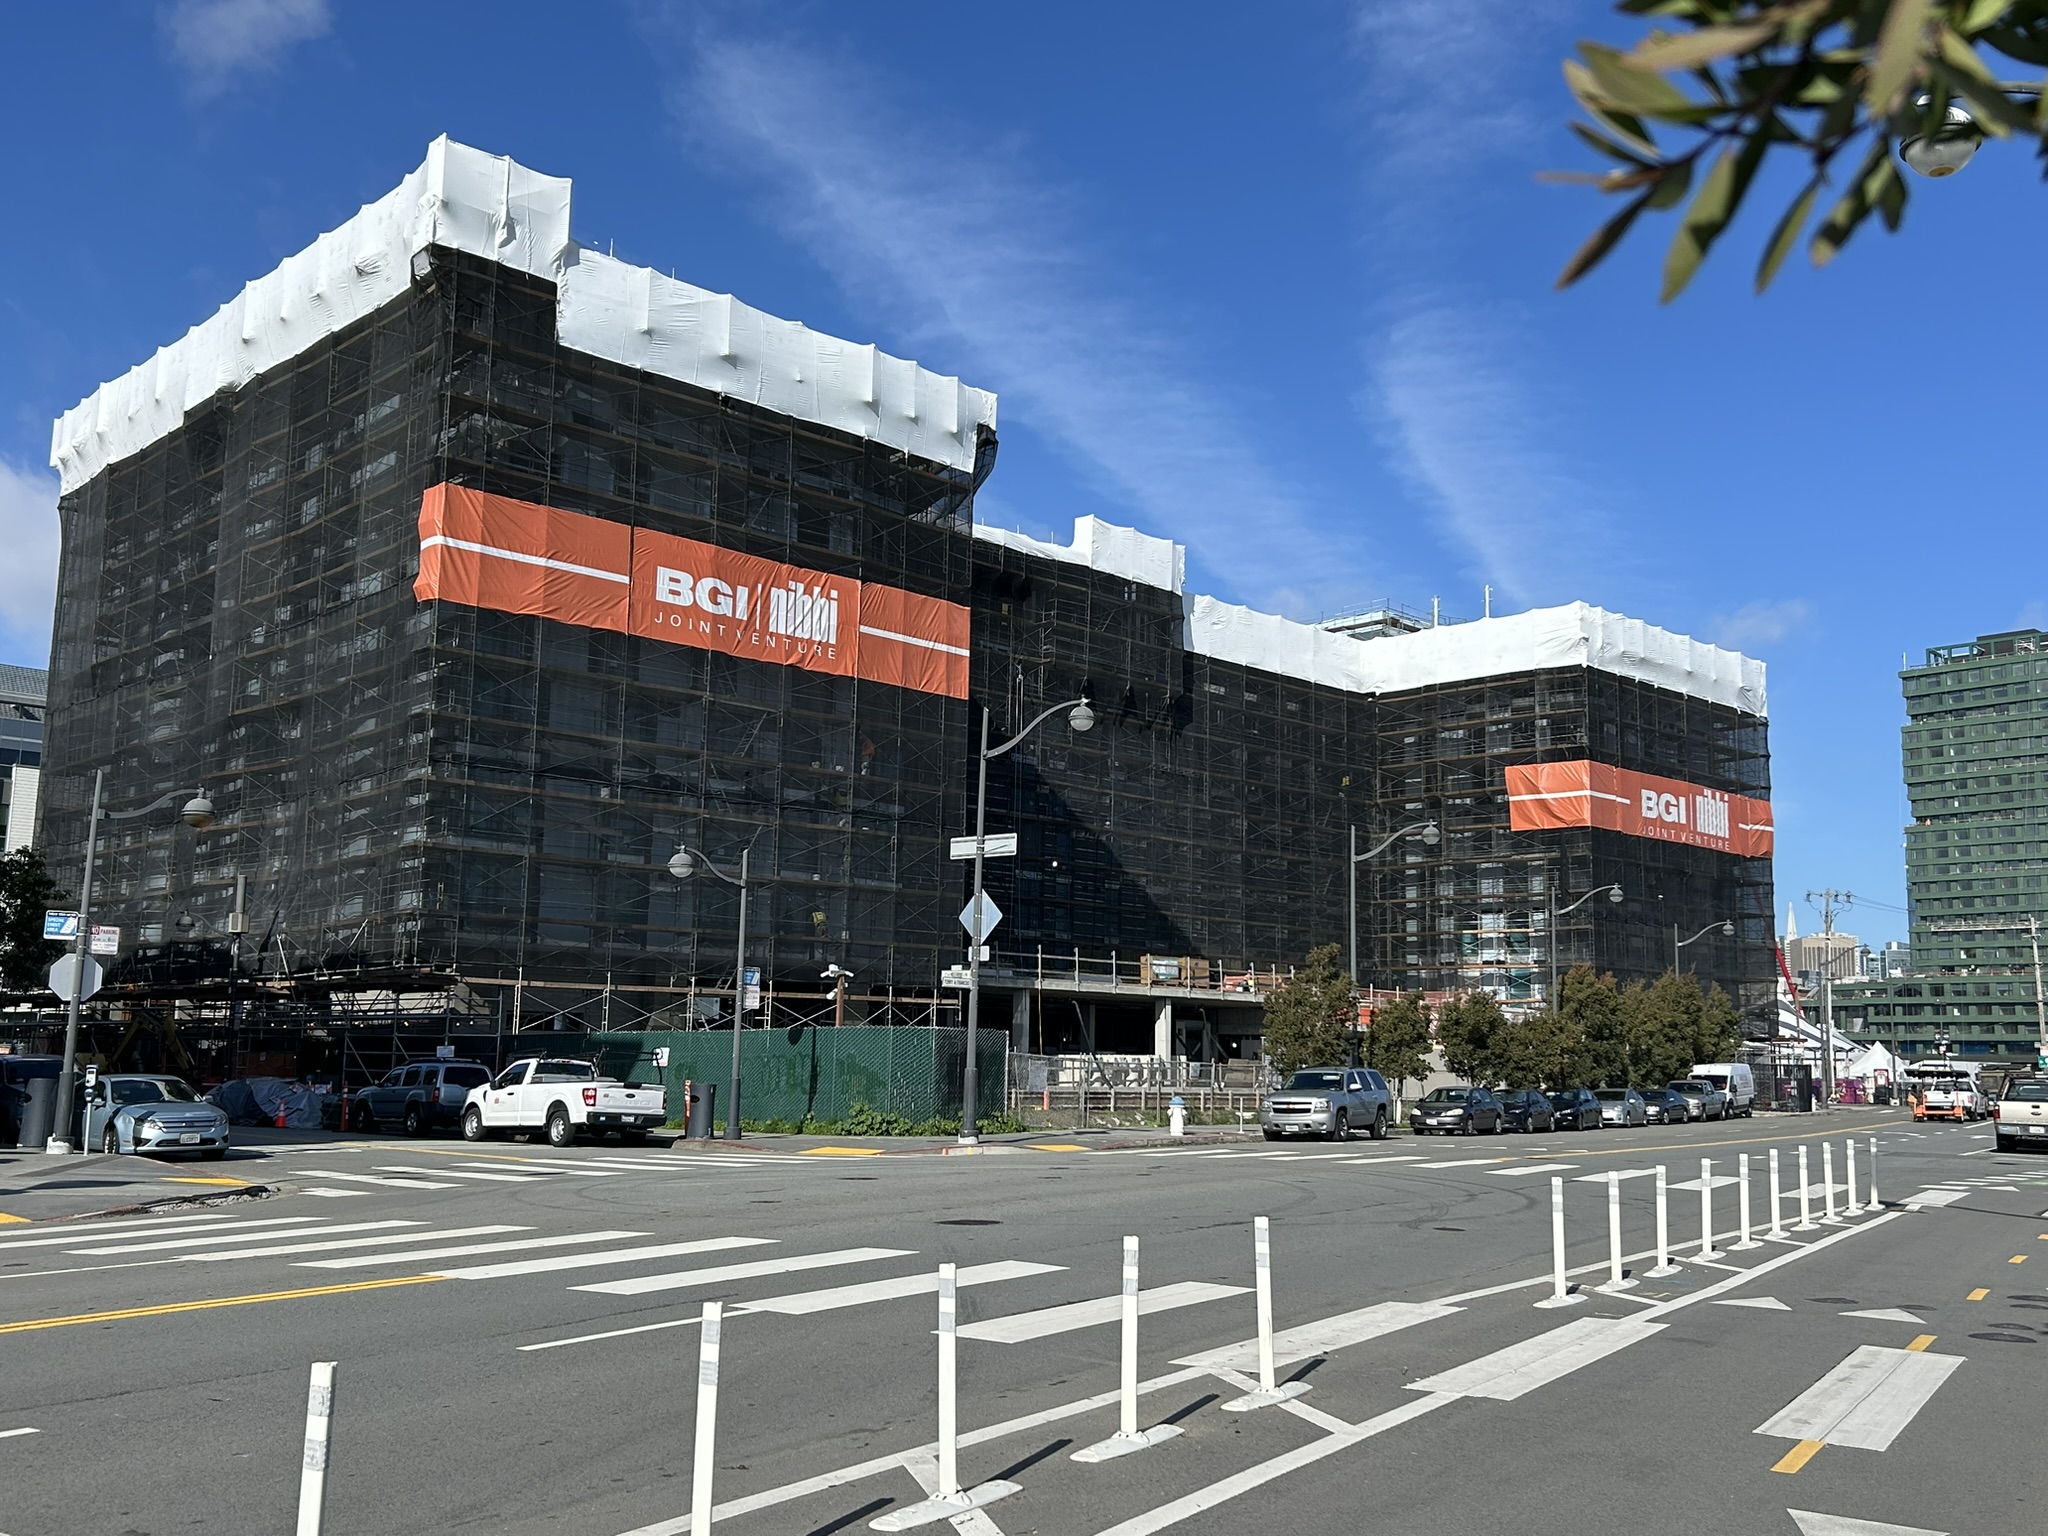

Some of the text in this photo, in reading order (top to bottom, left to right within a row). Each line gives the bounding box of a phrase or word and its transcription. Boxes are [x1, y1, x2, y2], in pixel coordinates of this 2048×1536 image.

[656, 565, 838, 644] BGI nibbi
[655, 612, 836, 660] JOINT VENTURE
[1641, 788, 1729, 838] BGI nibbi
[1642, 826, 1730, 850] JOINT VENTURE
